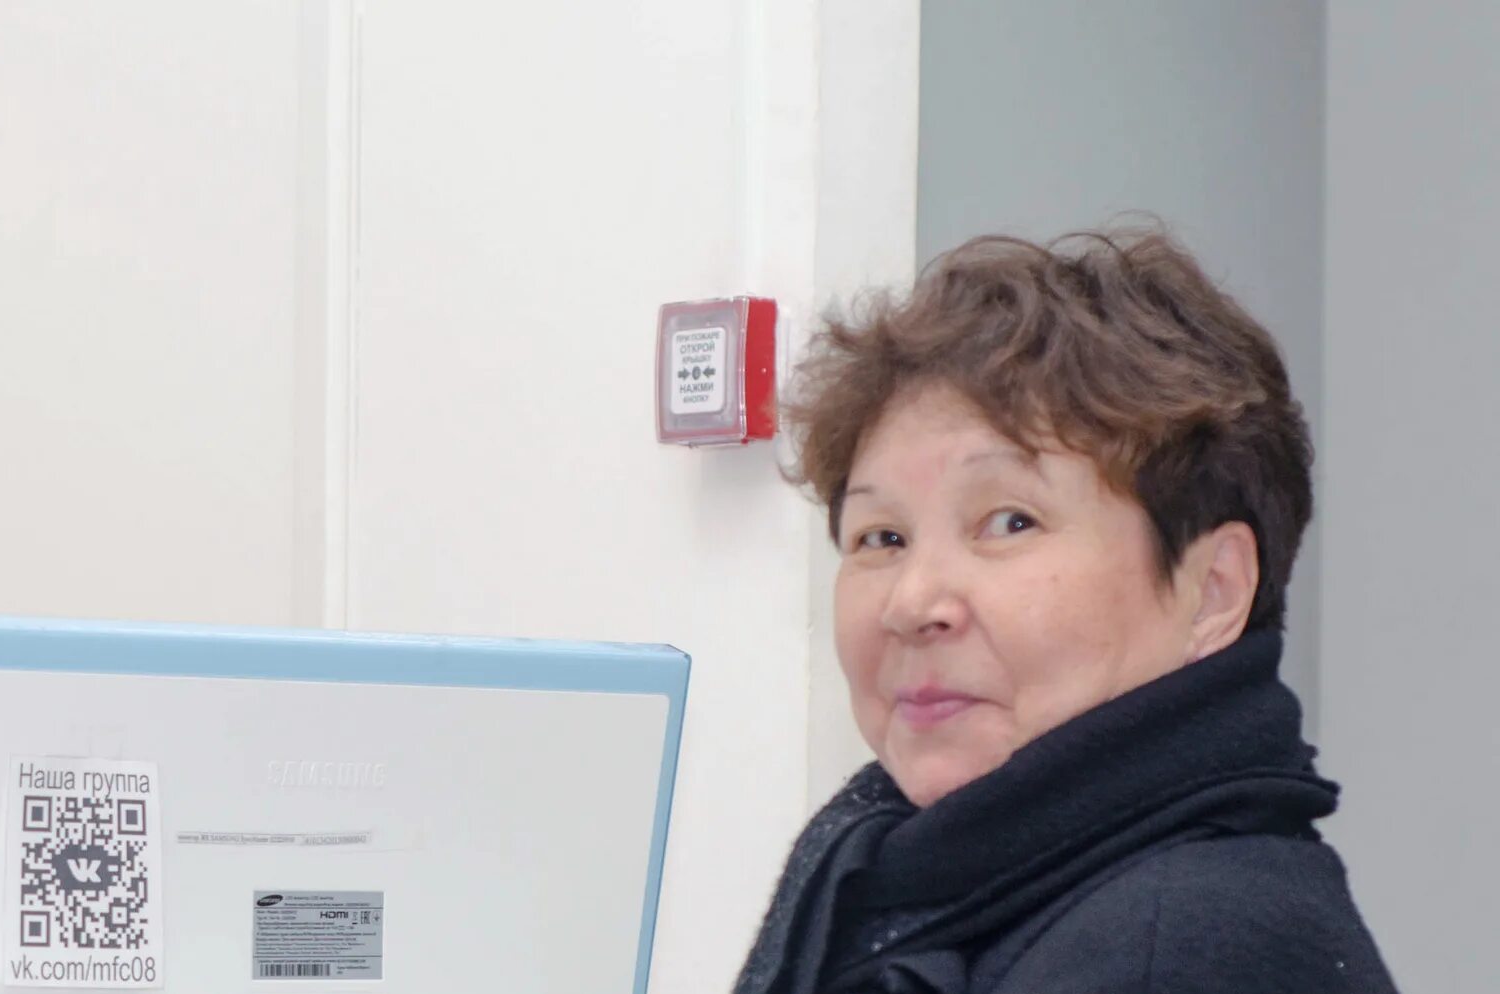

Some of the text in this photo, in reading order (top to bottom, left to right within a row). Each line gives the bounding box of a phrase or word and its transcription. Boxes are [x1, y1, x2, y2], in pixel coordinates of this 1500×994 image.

[680, 342, 715, 354] ОТКРОЙ
[680, 382, 714, 394] НАЖМИ
[18, 763, 150, 798] Наша группа
[268, 760, 388, 788] SAMSUNG
[320, 911, 349, 919] HDMI
[10, 954, 156, 983] vk.com/mfc08
